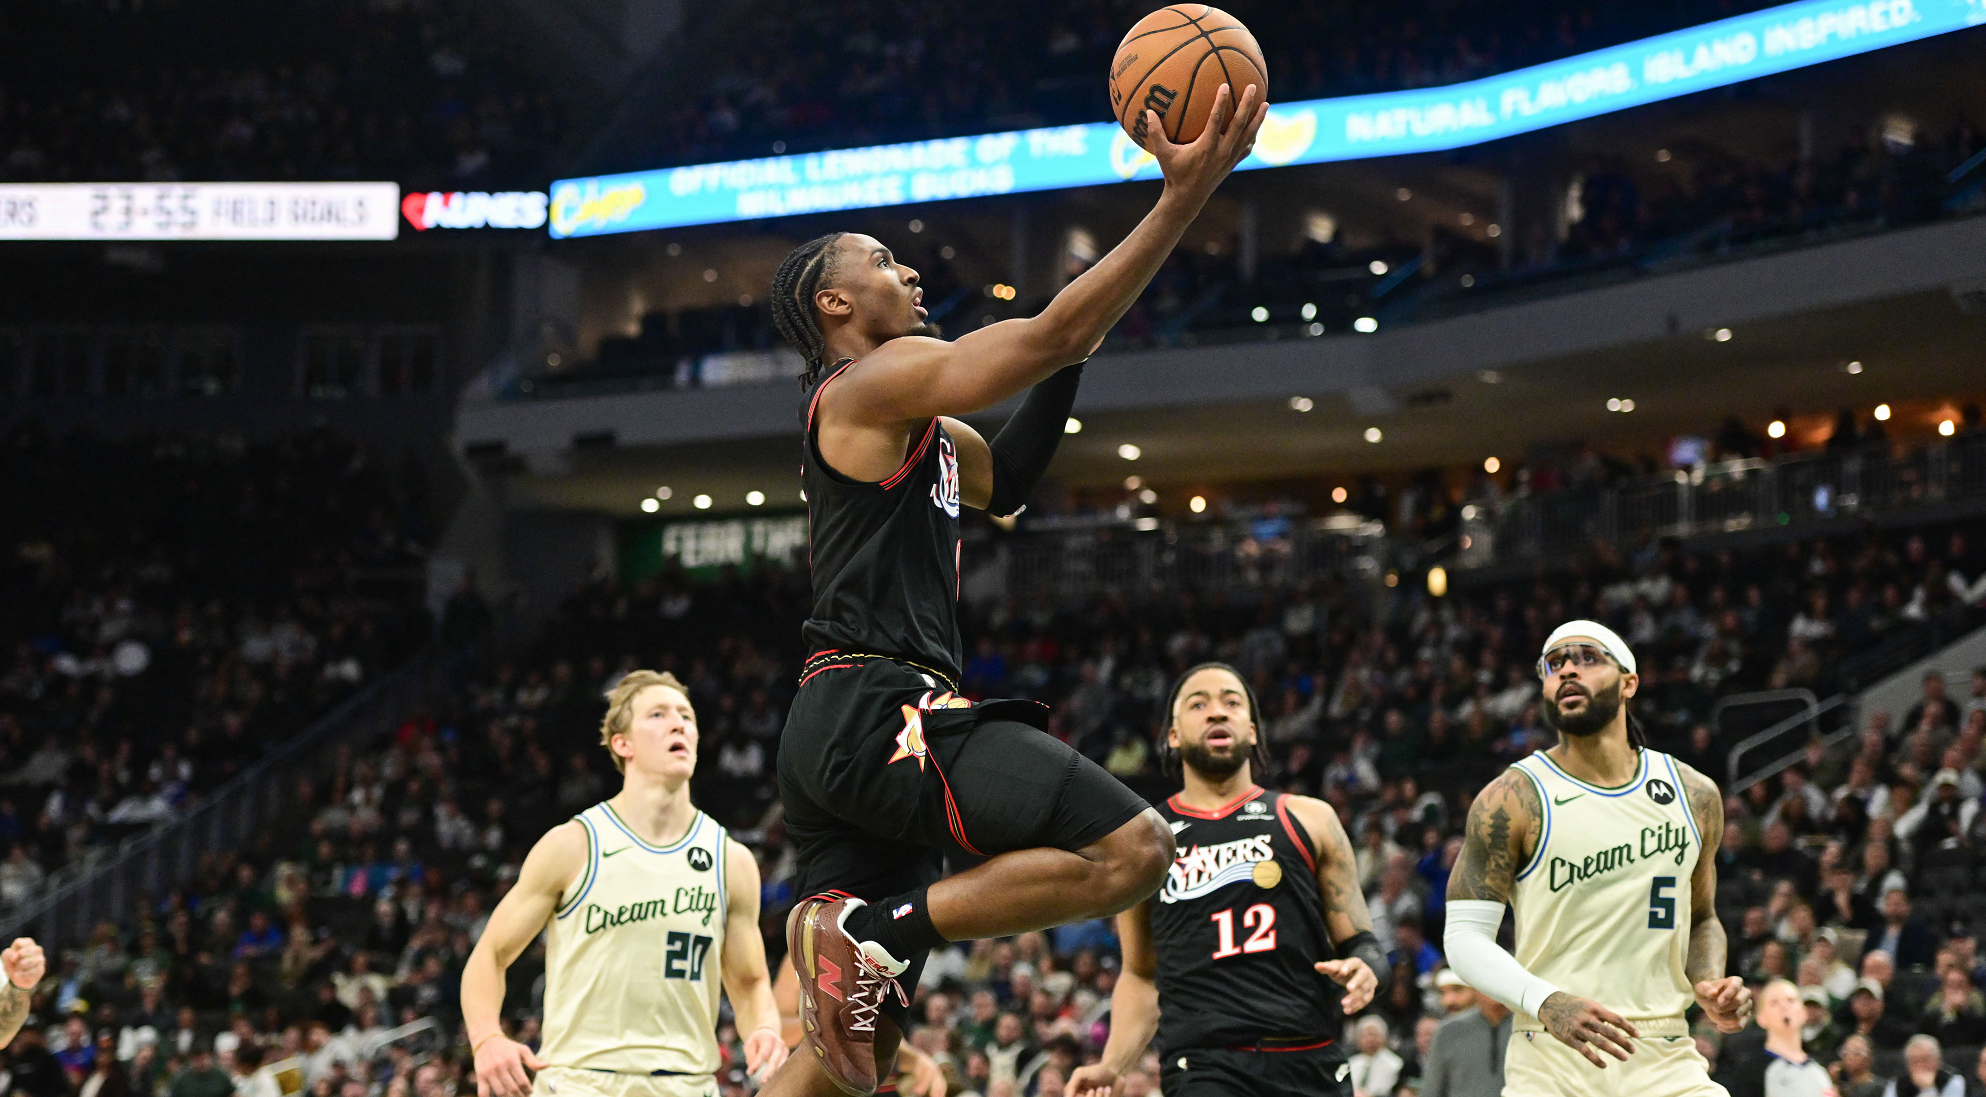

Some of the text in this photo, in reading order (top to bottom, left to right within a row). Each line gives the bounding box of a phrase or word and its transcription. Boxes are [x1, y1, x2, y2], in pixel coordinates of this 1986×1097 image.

[1346, 95, 1496, 143] NATURAL
[1643, 30, 1757, 86] ISLAND
[669, 157, 798, 197] OFFICIAL
[806, 138, 970, 181] LEMONADE
[976, 132, 1019, 163] OF
[1025, 125, 1089, 158] THE
[736, 164, 1015, 219] MILWAUKEE BUCKS
[661, 521, 744, 568] FEAR
[1550, 822, 1690, 893] Cream City
[585, 886, 717, 934] Cream City
[1648, 877, 1676, 929] 5
[665, 931, 714, 982] 20
[1211, 903, 1276, 960] 12
